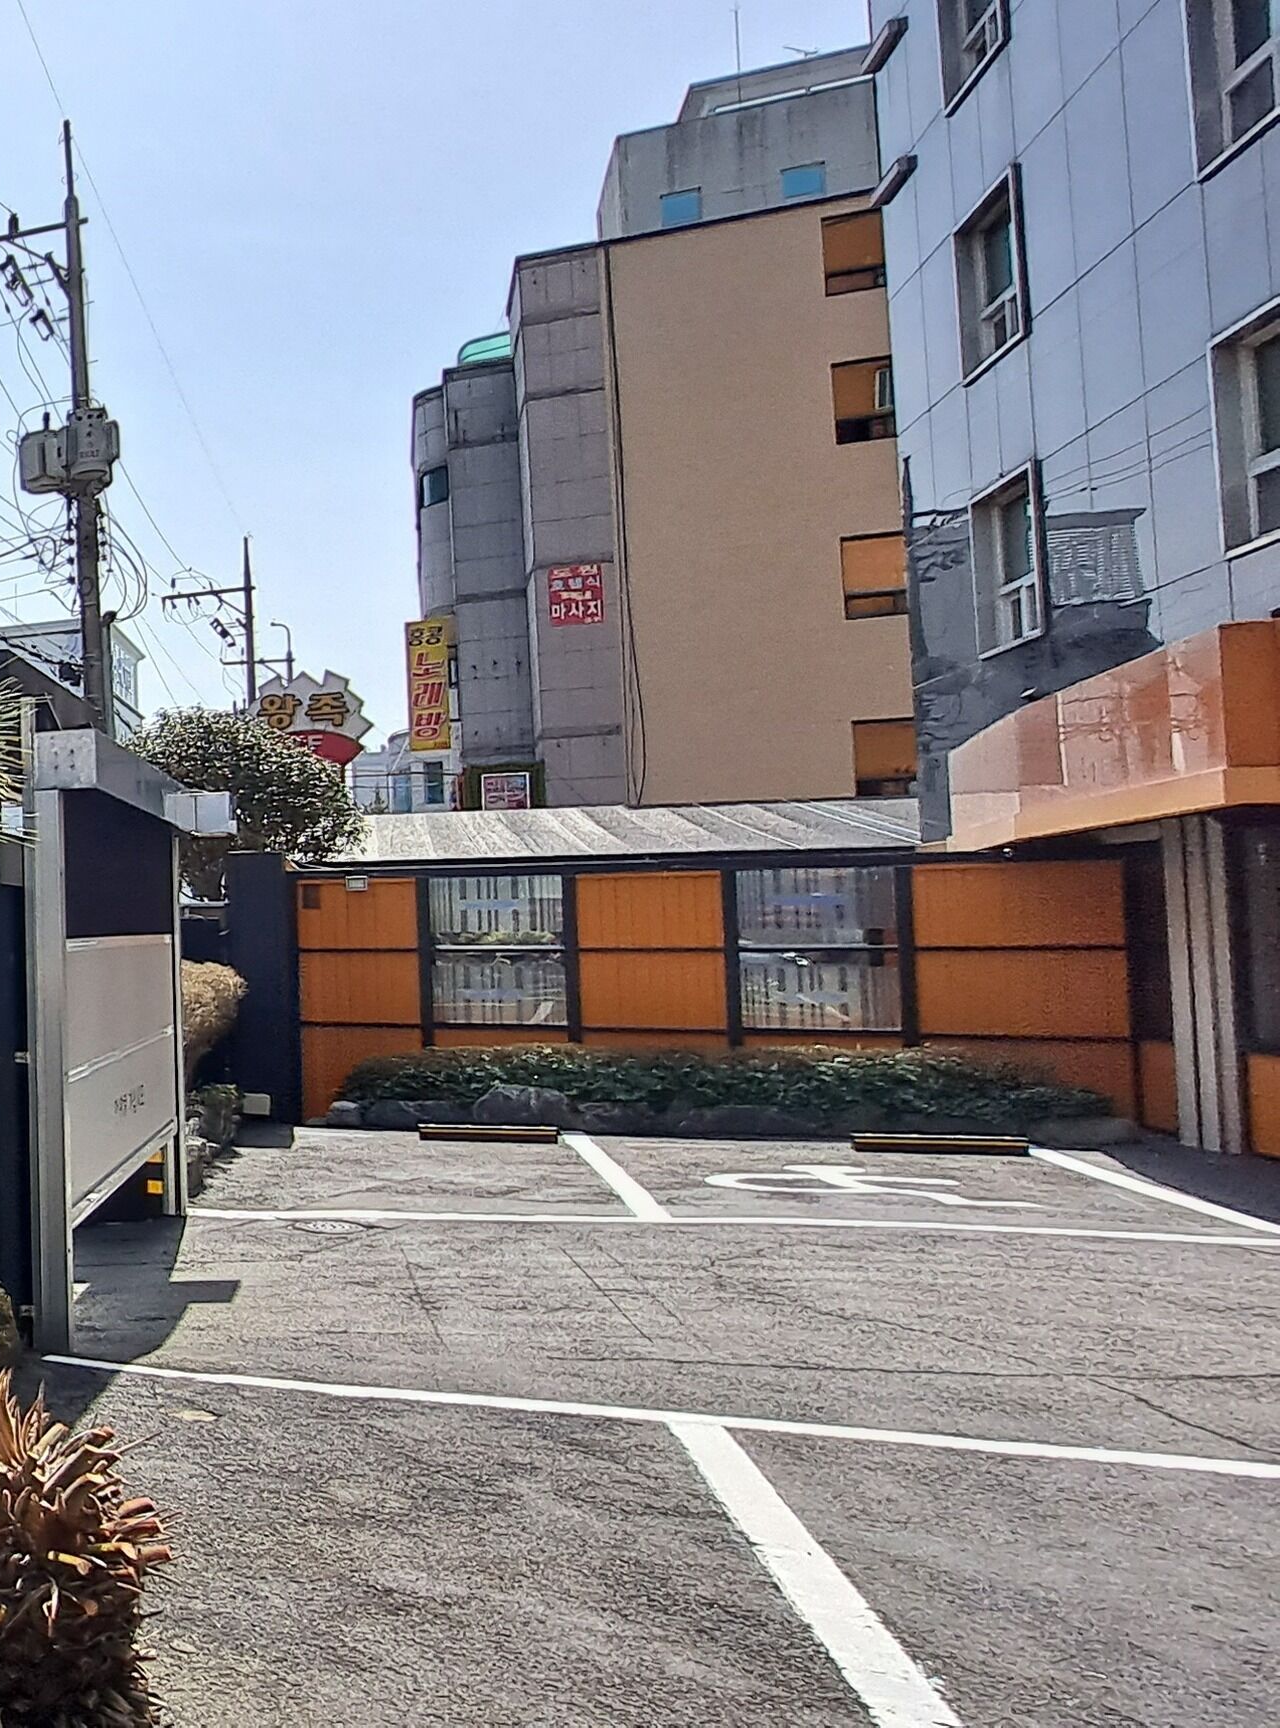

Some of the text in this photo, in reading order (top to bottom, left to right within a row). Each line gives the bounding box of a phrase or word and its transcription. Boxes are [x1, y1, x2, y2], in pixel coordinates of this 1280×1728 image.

[551, 599, 602, 620] 마사지
[409, 625, 443, 647] 홍콩
[412, 651, 447, 741] 노래방
